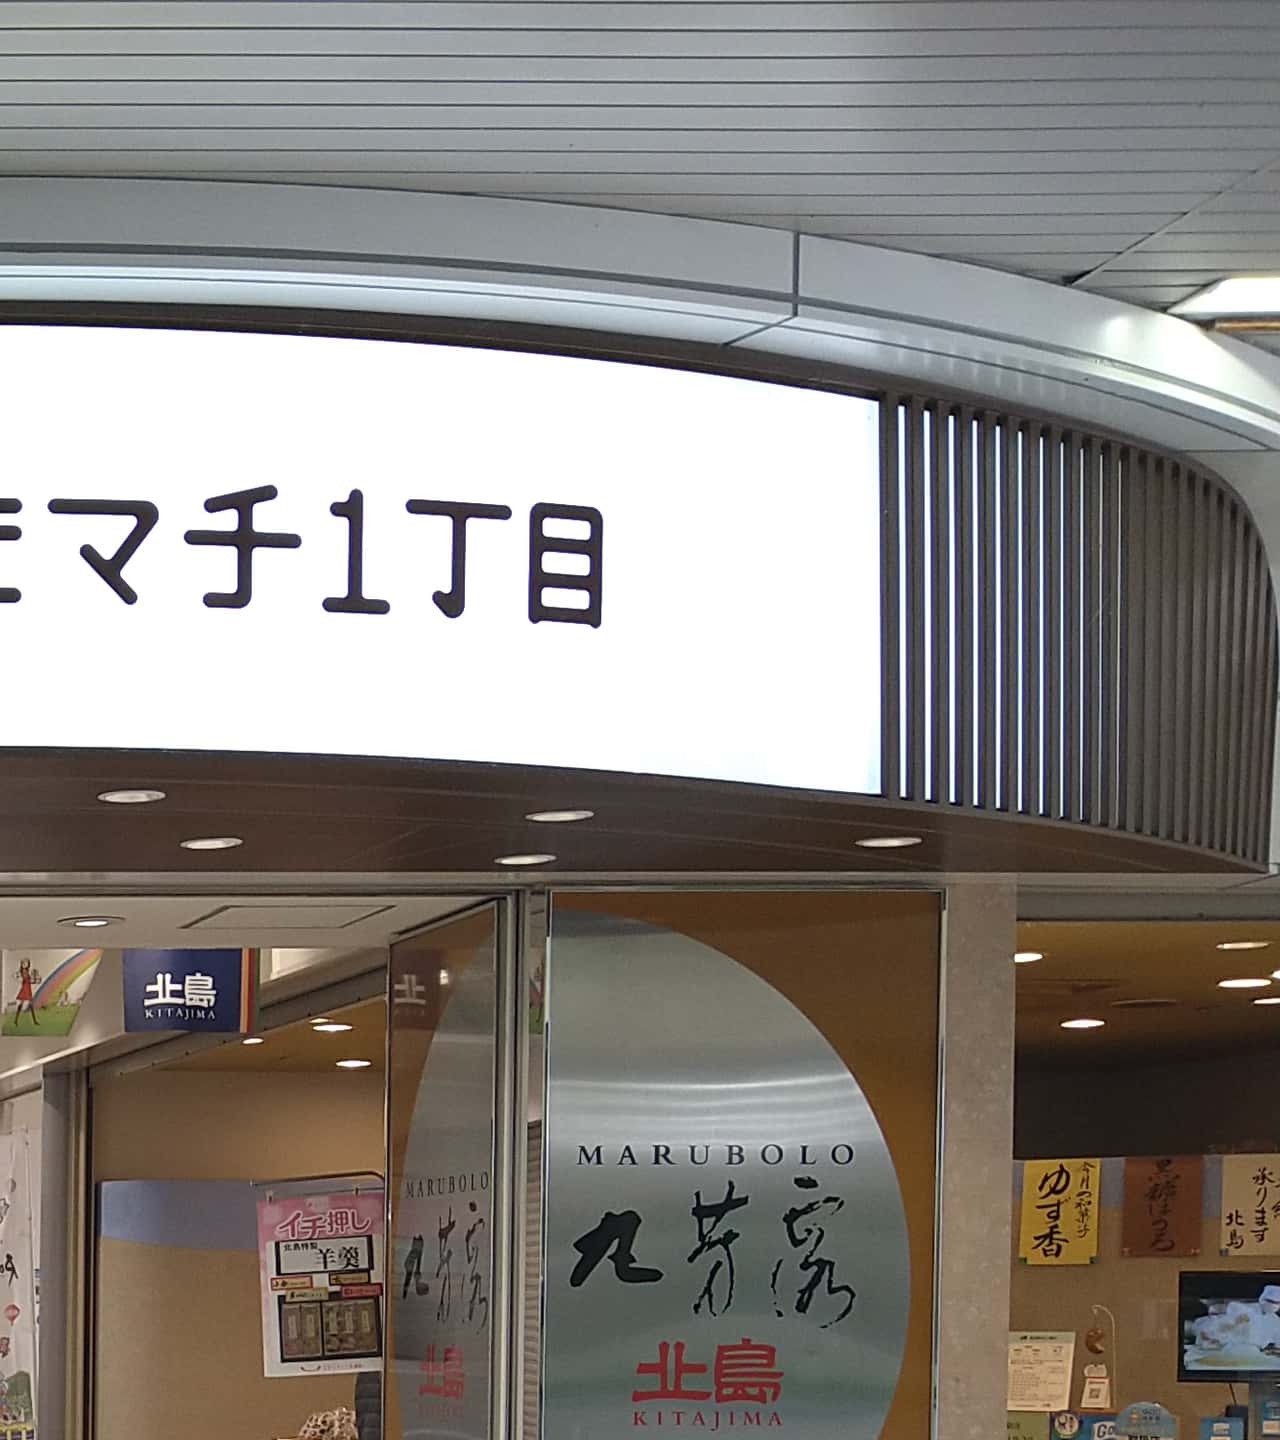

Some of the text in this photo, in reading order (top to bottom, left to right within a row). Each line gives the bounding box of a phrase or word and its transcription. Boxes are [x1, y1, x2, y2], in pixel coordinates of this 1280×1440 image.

[143, 972, 217, 1008] 北島
[144, 1008, 216, 1020] KITAJIMA
[575, 1144, 855, 1166] MARUBOLO
[406, 1171, 490, 1199] MARUBOLO
[1031, 1163, 1072, 1258] ゆず香
[277, 1211, 372, 1239] イチ押し
[1225, 1208, 1245, 1249] 北島
[317, 1246, 360, 1270] 羊羹
[631, 1336, 785, 1404] 北島
[632, 1410, 784, 1432] KITAJIMA
